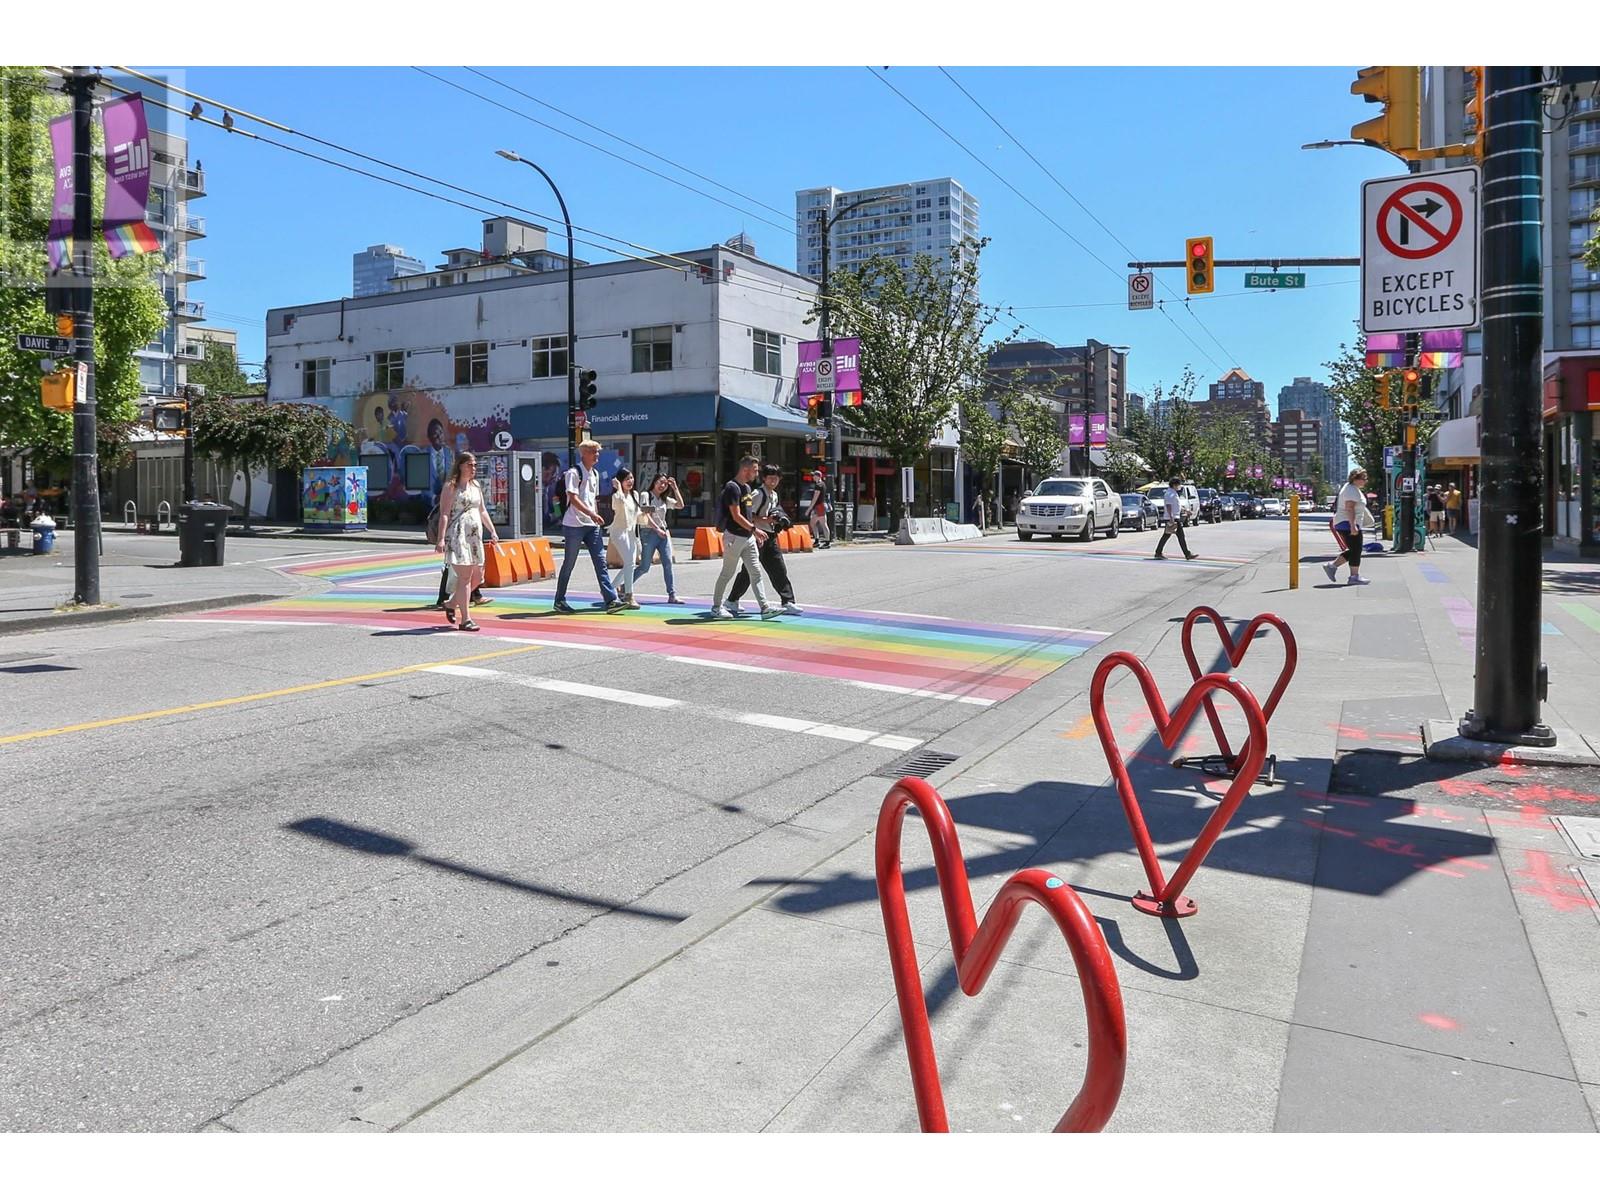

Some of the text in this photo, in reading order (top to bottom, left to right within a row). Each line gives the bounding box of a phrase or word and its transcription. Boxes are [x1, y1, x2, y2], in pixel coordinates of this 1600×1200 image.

[1250, 275, 1299, 286] Bute St
[1382, 270, 1454, 293] EXCEPT
[1373, 293, 1464, 317] BICYCLES
[25, 336, 50, 349] DAVIE
[591, 414, 619, 422] Financial
[621, 413, 649, 421] Services
